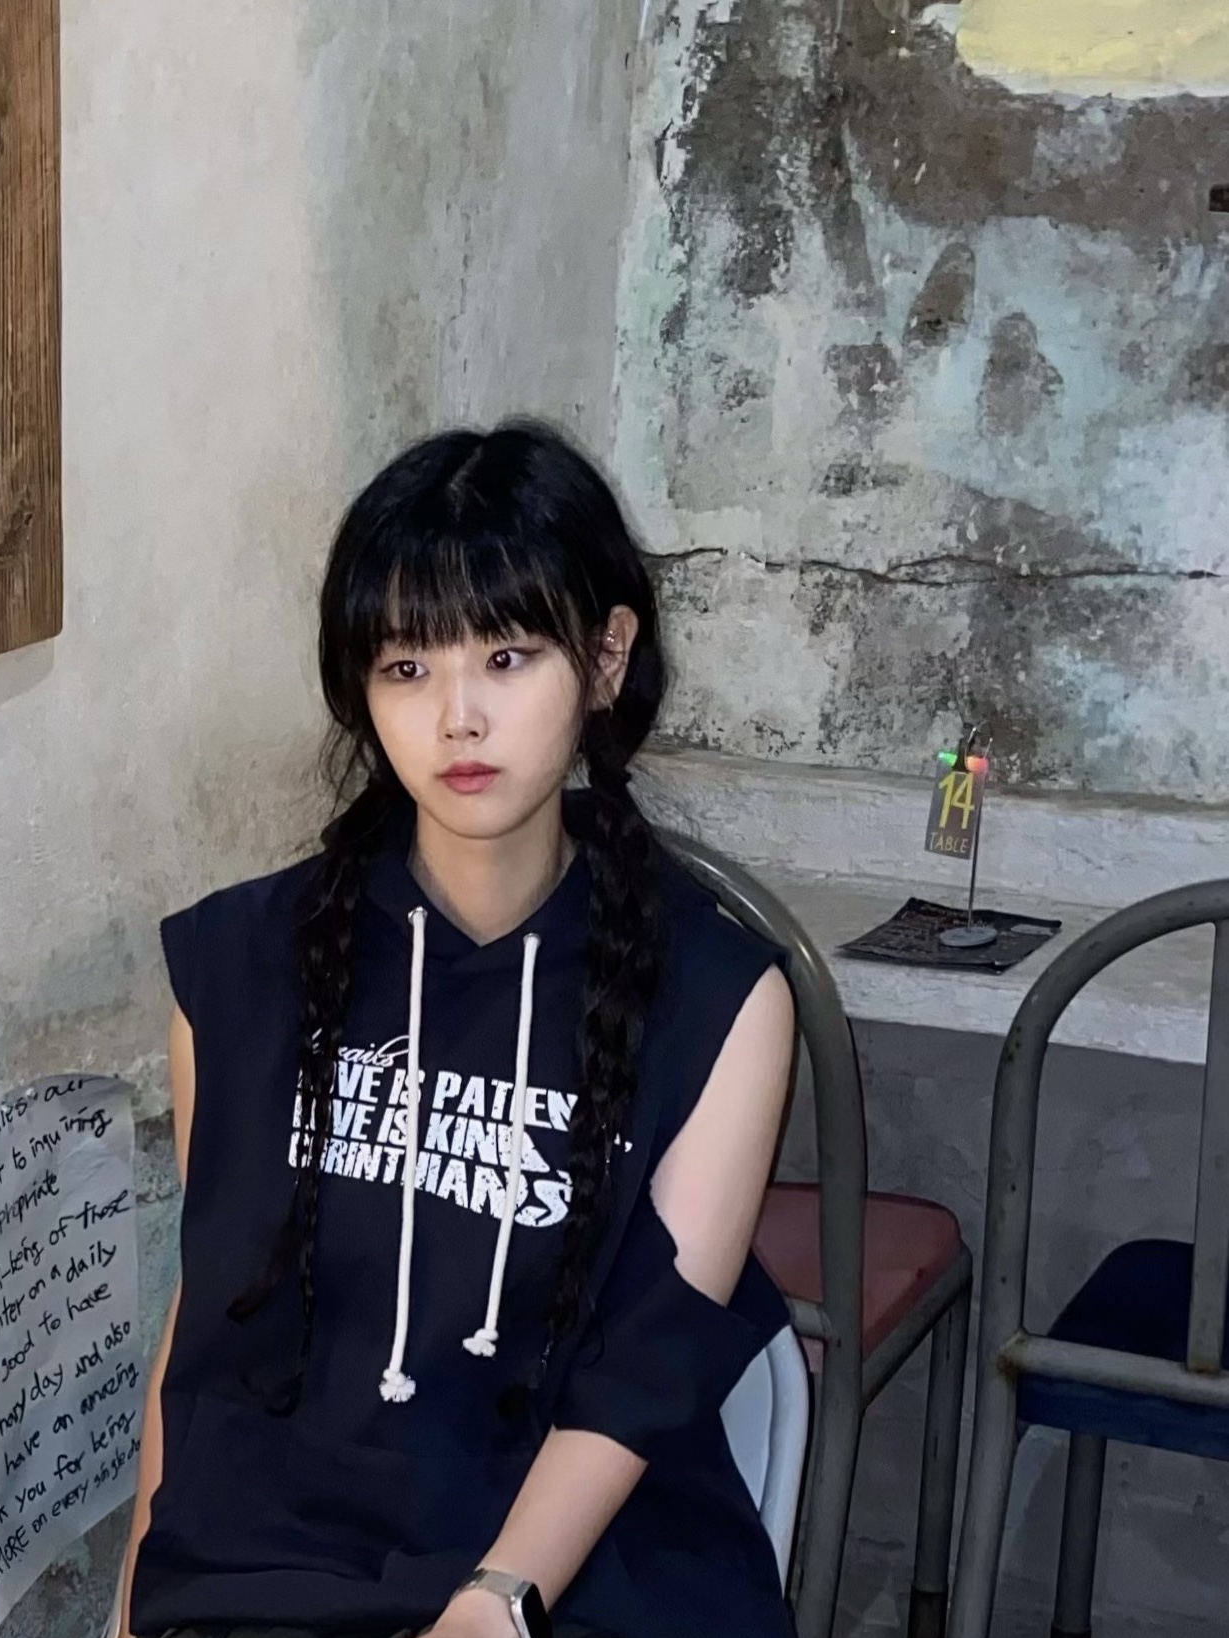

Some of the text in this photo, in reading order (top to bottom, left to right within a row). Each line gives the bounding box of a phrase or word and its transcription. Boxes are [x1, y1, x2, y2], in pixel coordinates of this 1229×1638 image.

[938, 770, 975, 830] 14
[929, 832, 969, 855] TABLE
[432, 1070, 578, 1132] PATEN
[12, 1147, 27, 1170] to
[49, 1216, 74, 1245] of
[29, 1278, 46, 1299] on
[51, 1264, 61, 1280] a
[67, 1240, 117, 1283] daily
[2, 1329, 34, 1383] good
[38, 1311, 61, 1336] to
[66, 1283, 112, 1320] have
[30, 1363, 63, 1401] day
[105, 1321, 131, 1350] also
[4, 1430, 41, 1477] have
[53, 1413, 74, 1434] an
[80, 1362, 140, 1415] amazing
[15, 1481, 47, 1514] you
[54, 1451, 86, 1480] for
[91, 1410, 137, 1453] being
[32, 1513, 48, 1533] on
[52, 1479, 89, 1517] every
